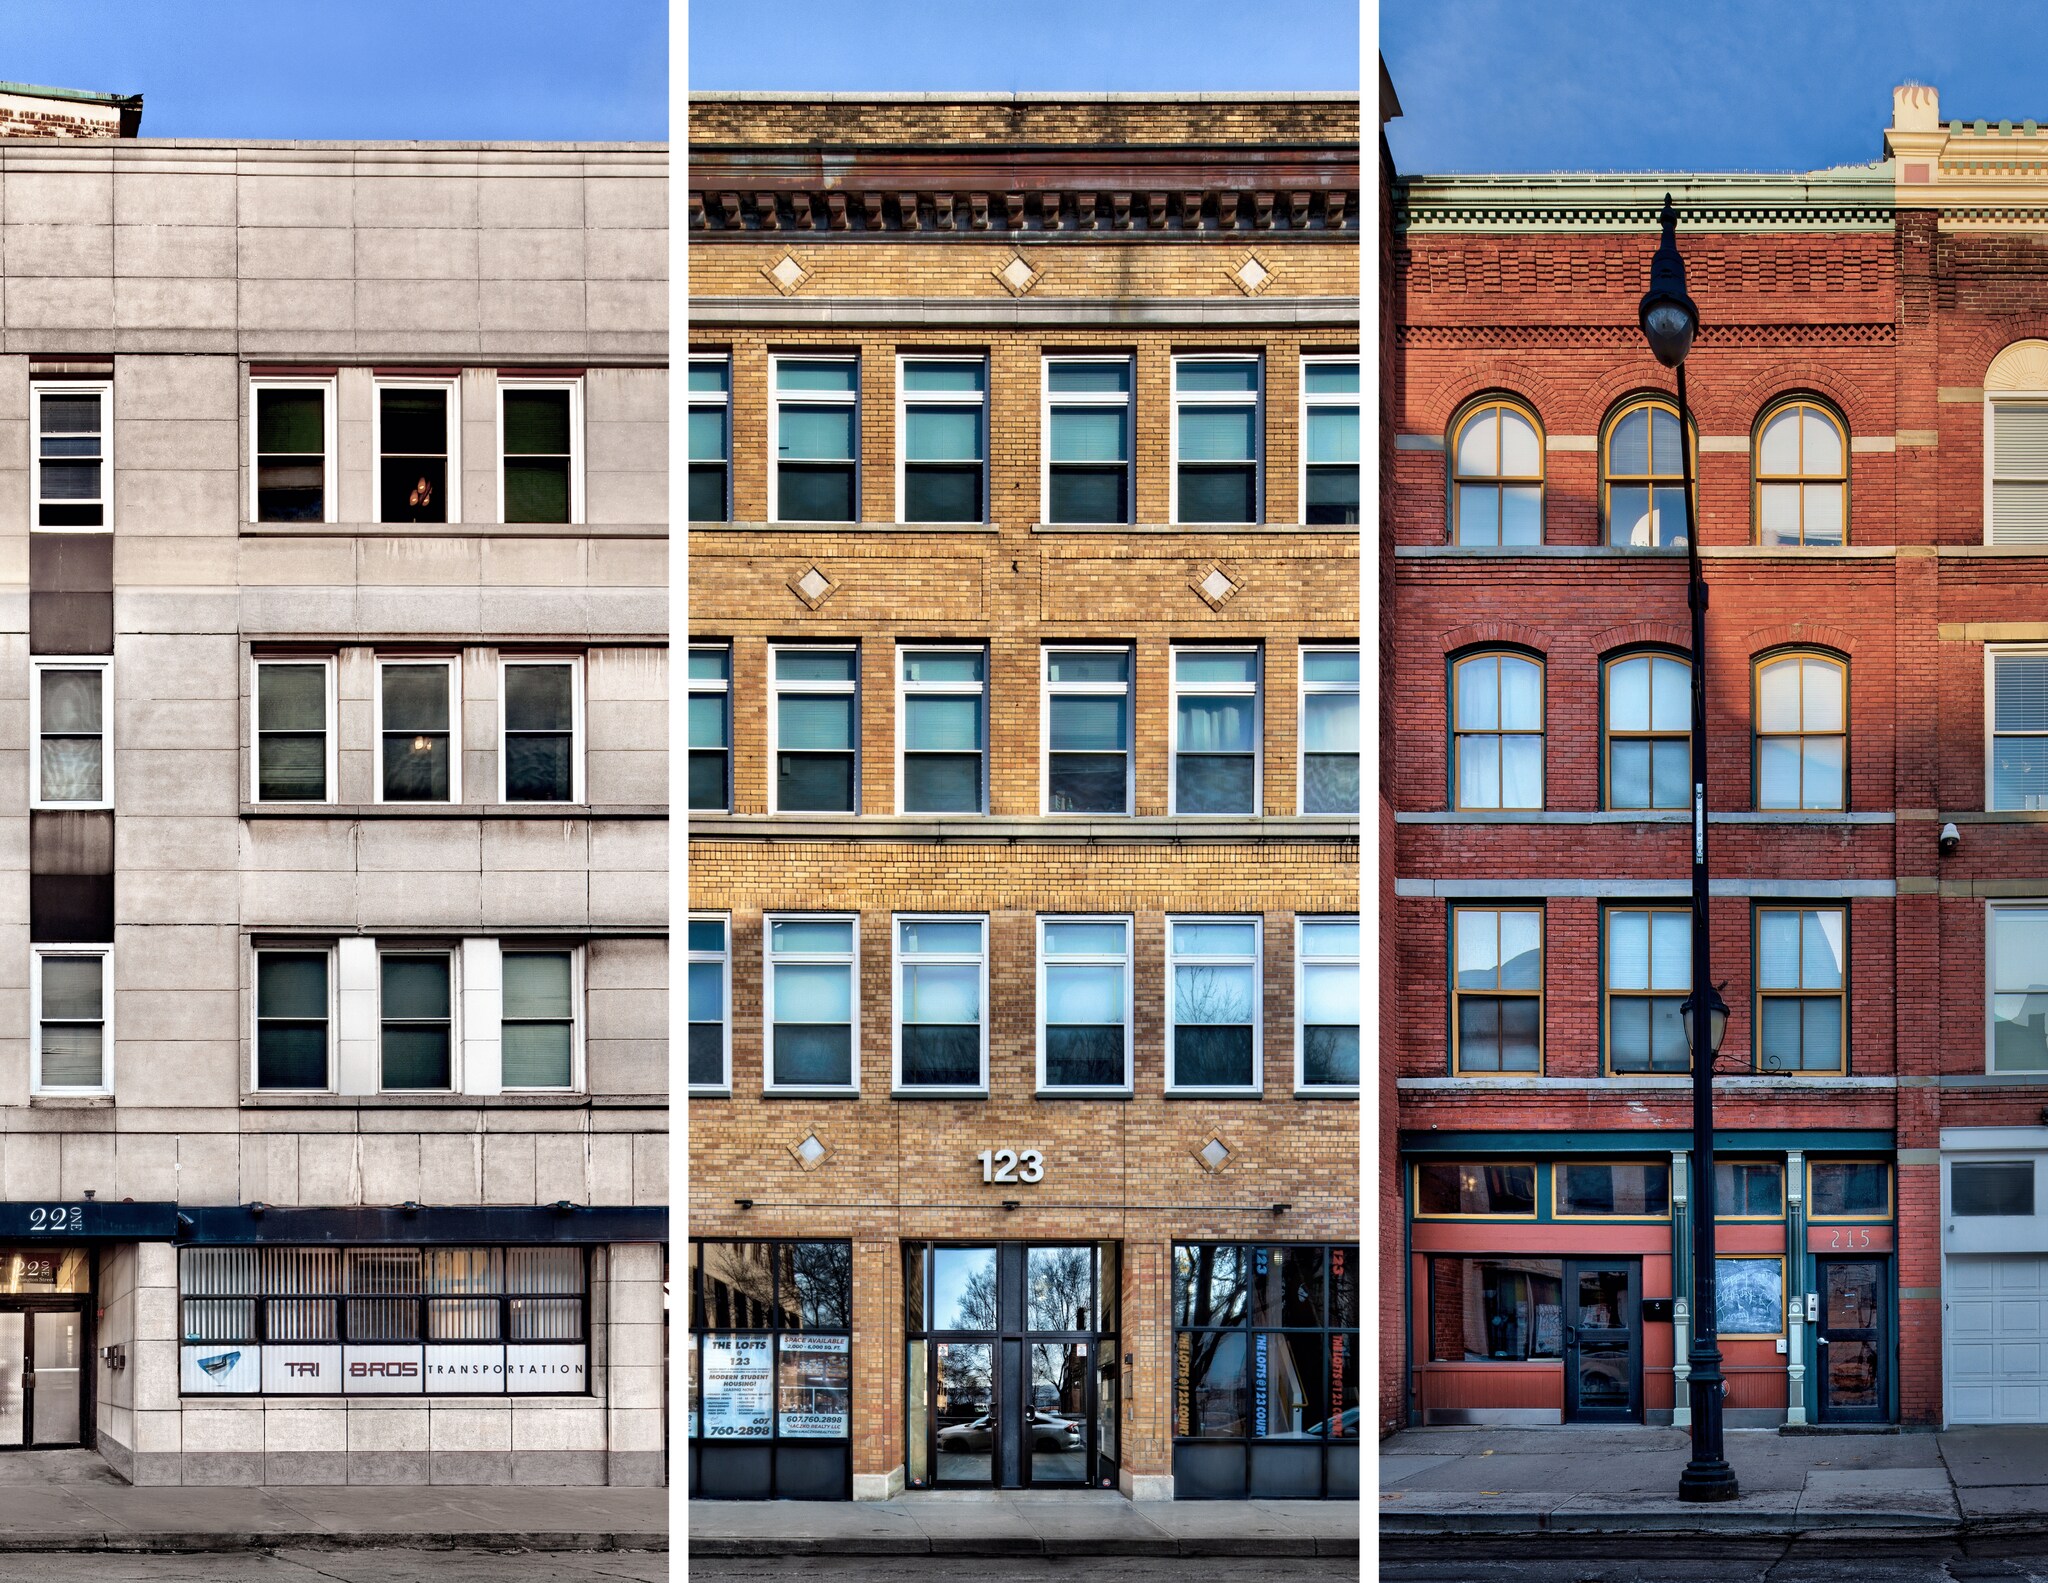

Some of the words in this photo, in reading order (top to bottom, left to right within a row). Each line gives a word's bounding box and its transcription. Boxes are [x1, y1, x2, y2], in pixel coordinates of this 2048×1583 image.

[978, 1149, 1045, 1183] 123
[30, 1207, 68, 1230] 22
[70, 1207, 82, 1231] ONE
[1831, 1229, 1871, 1248] 215
[41, 1260, 50, 1277] ONE
[1257, 1249, 1268, 1275] 123
[1333, 1249, 1345, 1275] 123
[712, 1341, 731, 1349] THE
[735, 1341, 767, 1349] LOFTS
[808, 1337, 845, 1345] AVAILABLE
[1256, 1334, 1267, 1351] THE
[284, 1362, 320, 1377] TRI
[348, 1362, 418, 1377] BROS
[428, 1364, 583, 1374] TRANSPORTATION
[730, 1357, 750, 1366] 123
[1178, 1351, 1190, 1378] LOFTS
[1256, 1351, 1267, 1379] LOFTS
[1332, 1352, 1343, 1379] LOFTS
[1178, 1386, 1190, 1404] 123
[1256, 1387, 1267, 1406] 123
[1332, 1387, 1343, 1406] 123
[752, 1417, 770, 1425] 607
[786, 1416, 842, 1424] 607.760.2898
[1178, 1406, 1190, 1436] COURT
[1256, 1406, 1267, 1438] COURT
[710, 1426, 770, 1435] 760-2898
